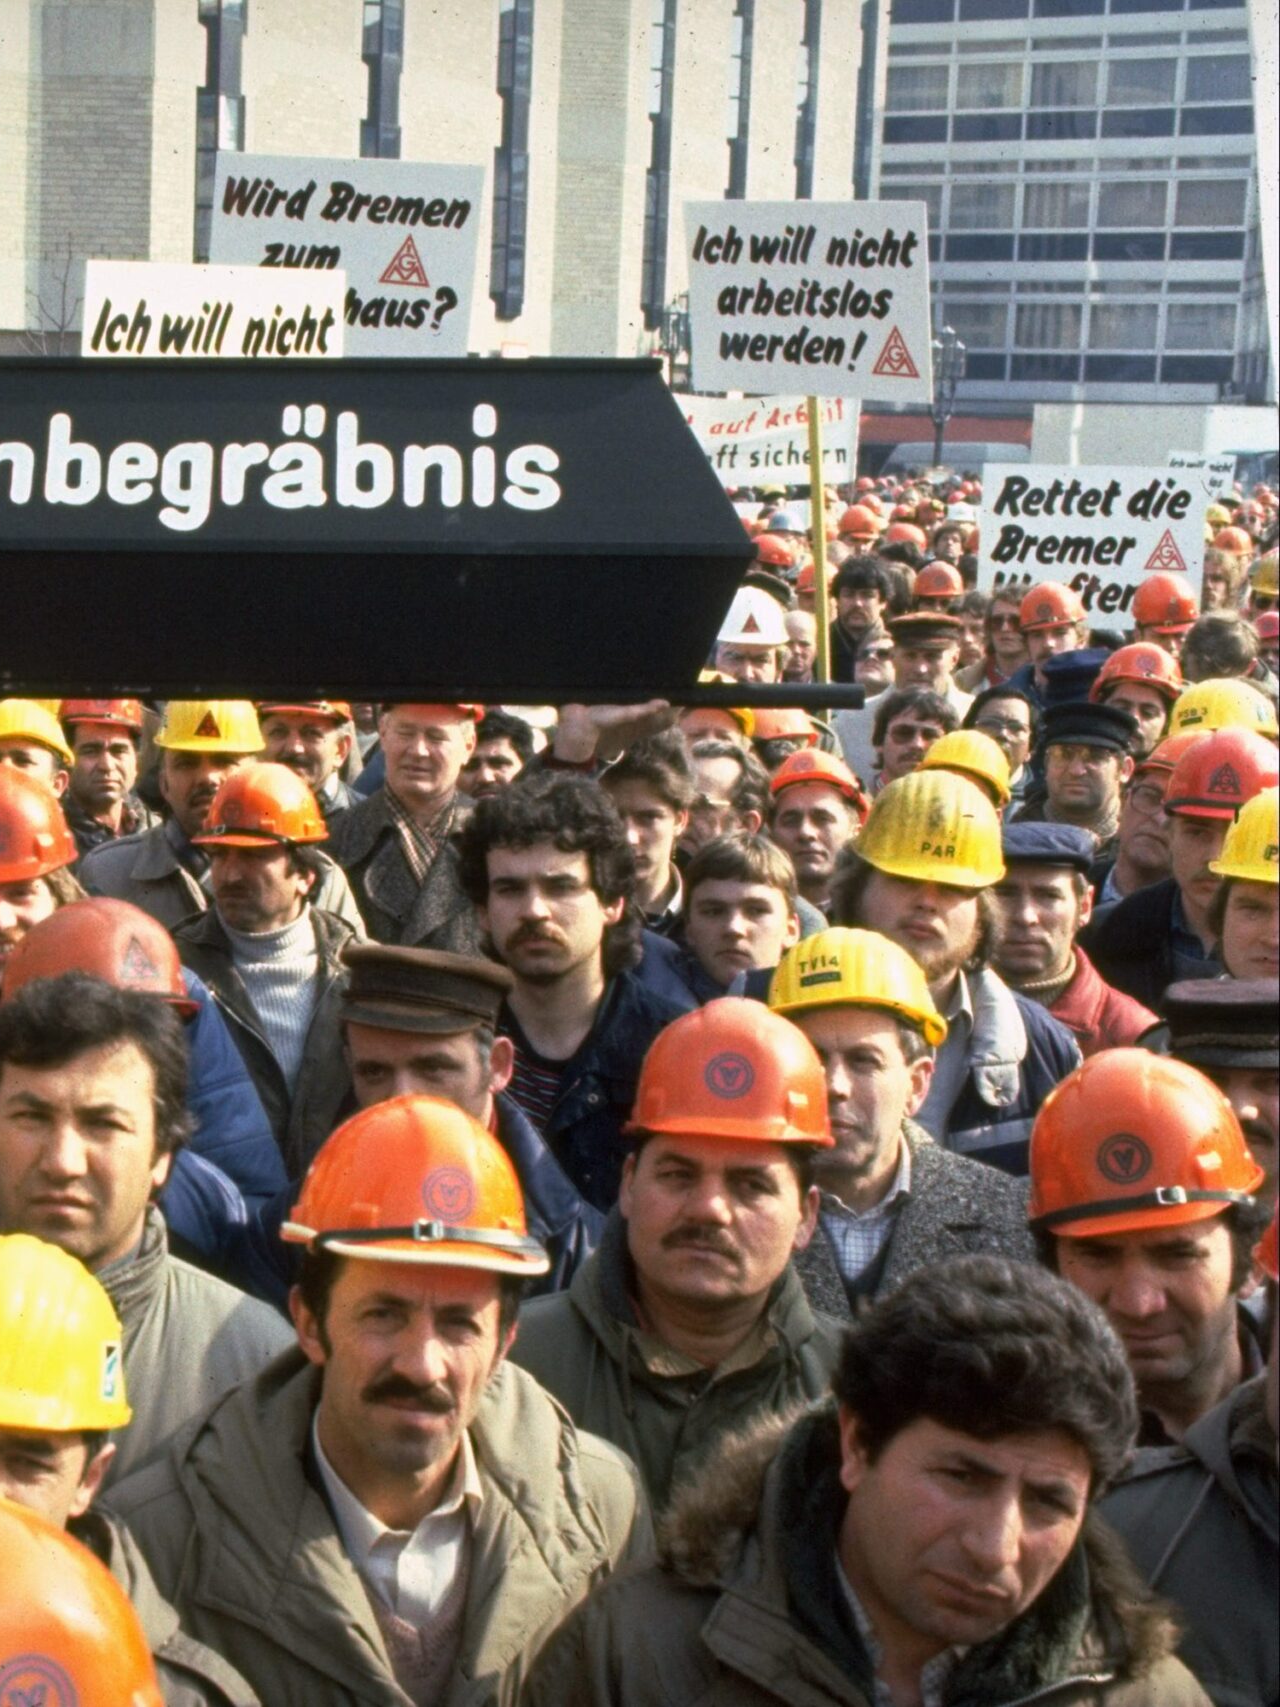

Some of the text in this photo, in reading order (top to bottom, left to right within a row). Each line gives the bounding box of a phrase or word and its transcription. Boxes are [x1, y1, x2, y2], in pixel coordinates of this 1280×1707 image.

[222, 176, 471, 229] Wird Bremen
[260, 243, 340, 270] zum
[692, 224, 918, 268] Ich will nicht
[718, 277, 893, 320] arbeitslos
[91, 298, 334, 357] Ich will nicht
[765, 397, 843, 429] Arbit
[994, 475, 1192, 520] Rettet die
[990, 524, 1136, 566] Bremer
[920, 842, 955, 858] PAR
